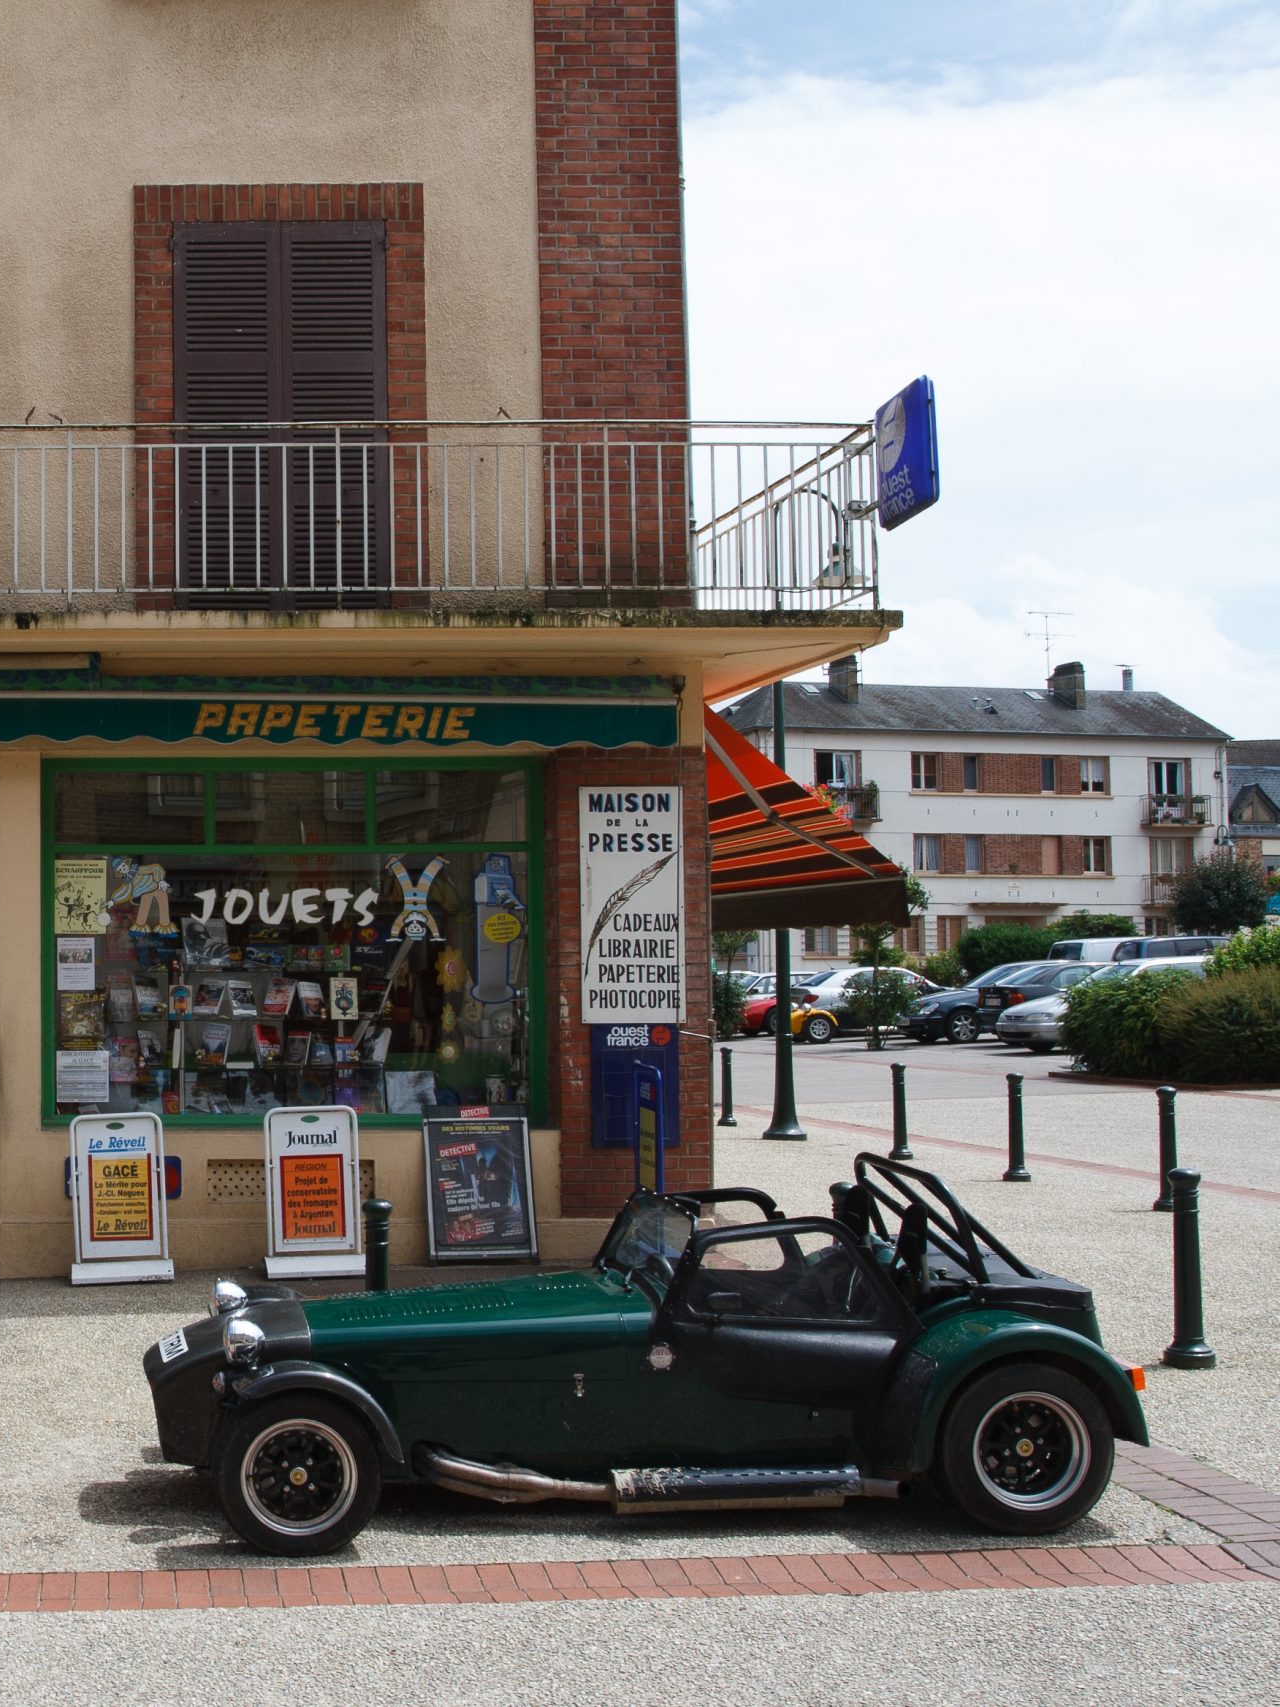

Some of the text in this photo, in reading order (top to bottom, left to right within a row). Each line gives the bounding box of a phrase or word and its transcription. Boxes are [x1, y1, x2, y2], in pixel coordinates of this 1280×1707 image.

[881, 464, 912, 498] ouest
[880, 487, 915, 520] france
[192, 703, 476, 739] PAPETERIE
[588, 793, 670, 813] MAISON
[606, 819, 649, 827] DE LA
[588, 833, 672, 852] PRESSE
[190, 888, 380, 927] JOUETS
[613, 913, 679, 932] CADEAUX
[598, 939, 675, 958] LIBRAIRIE
[598, 964, 680, 983] PAPETERIE
[589, 990, 681, 1009] PHOTOCOPIE
[611, 1025, 650, 1036] ouest
[606, 1034, 650, 1046] france
[460, 1106, 489, 1118] DETECTIVE
[88, 1136, 146, 1149] Le Réveil
[286, 1130, 338, 1148] Journal
[440, 1143, 477, 1157] DETECTIVE
[102, 1161, 139, 1177] GACÉ
[294, 1162, 328, 1171] RÉGION
[106, 1181, 129, 1189] Mérite
[131, 1181, 147, 1190] pour
[295, 1176, 328, 1186] Projet de
[118, 1190, 145, 1198] Nogues
[287, 1188, 337, 1197] conservatoire
[288, 1199, 337, 1209] des fromages
[293, 1211, 334, 1220] à Argentan
[96, 1218, 148, 1232] Le Réveil
[293, 1221, 337, 1236] Journal
